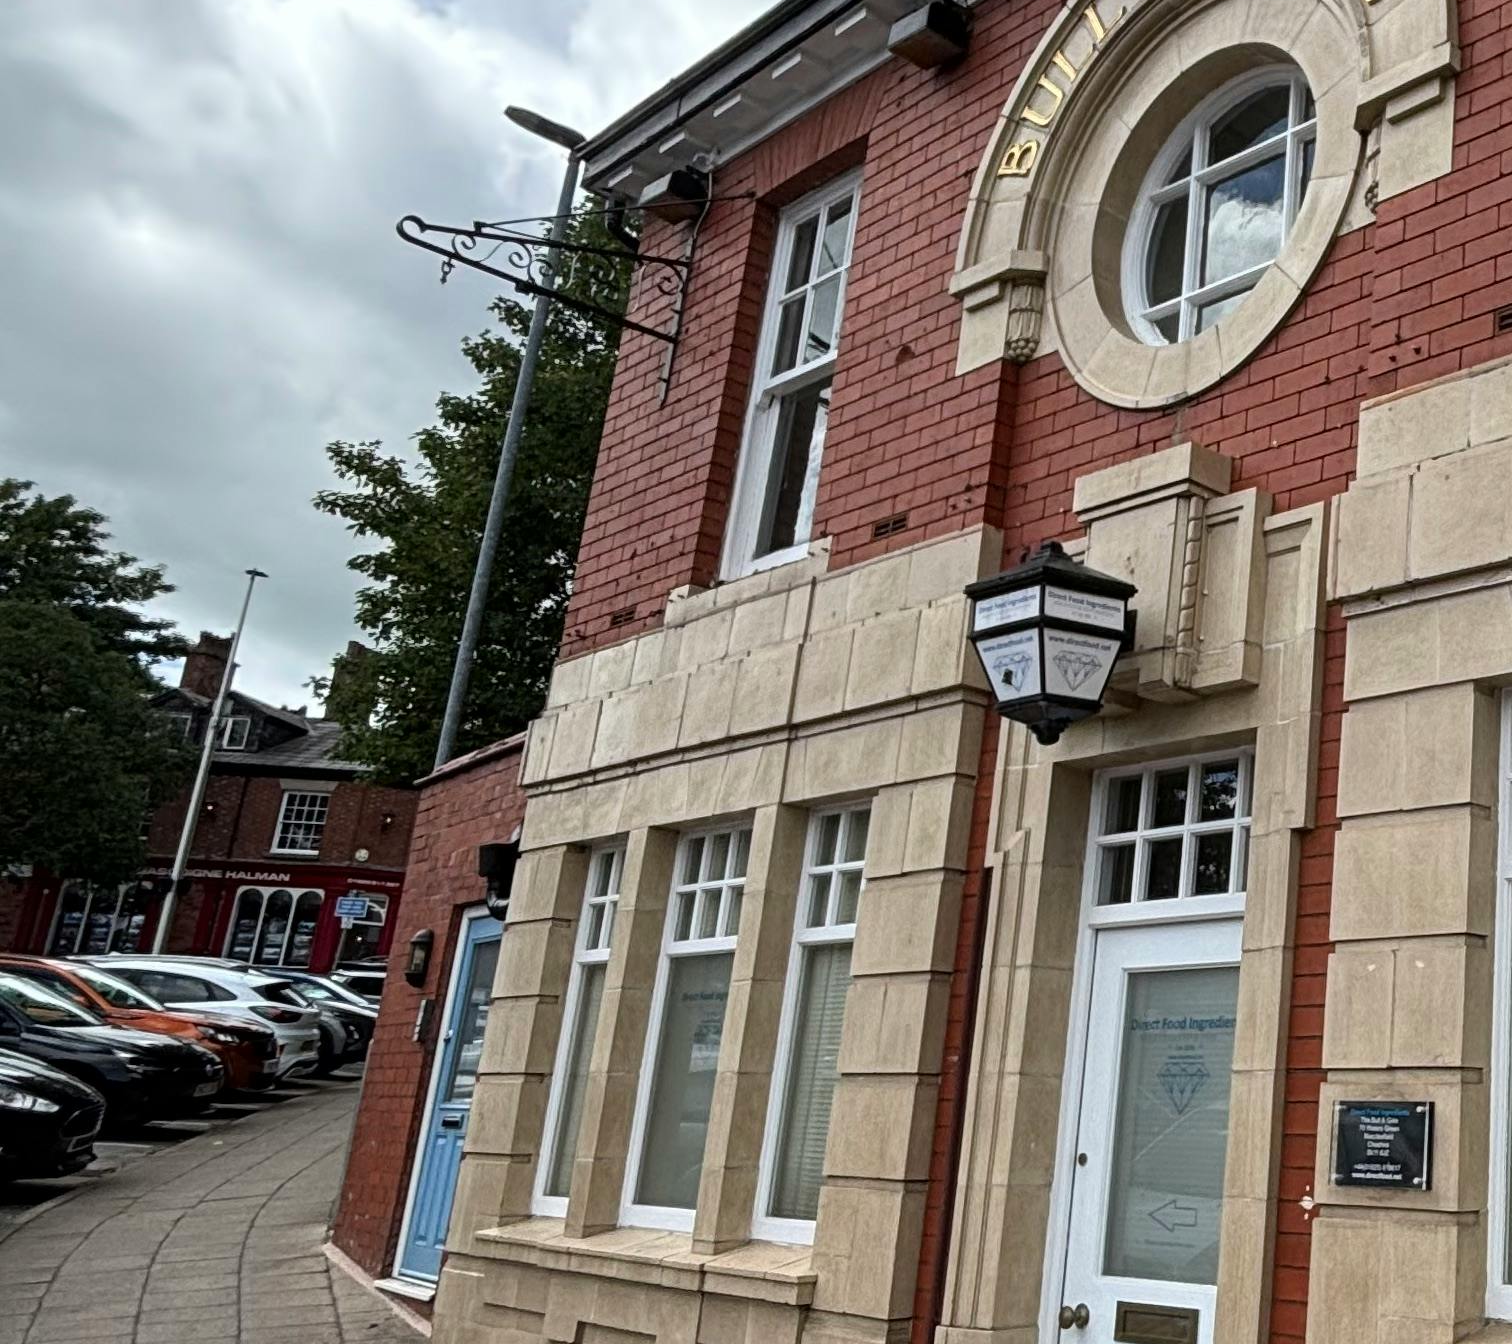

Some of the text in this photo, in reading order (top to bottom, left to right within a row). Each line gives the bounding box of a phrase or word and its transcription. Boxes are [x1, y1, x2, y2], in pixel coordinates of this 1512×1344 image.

[997, 1, 1127, 177] BULL
[225, 870, 291, 882] HALMAN
[1162, 1016, 1187, 1030] Food
